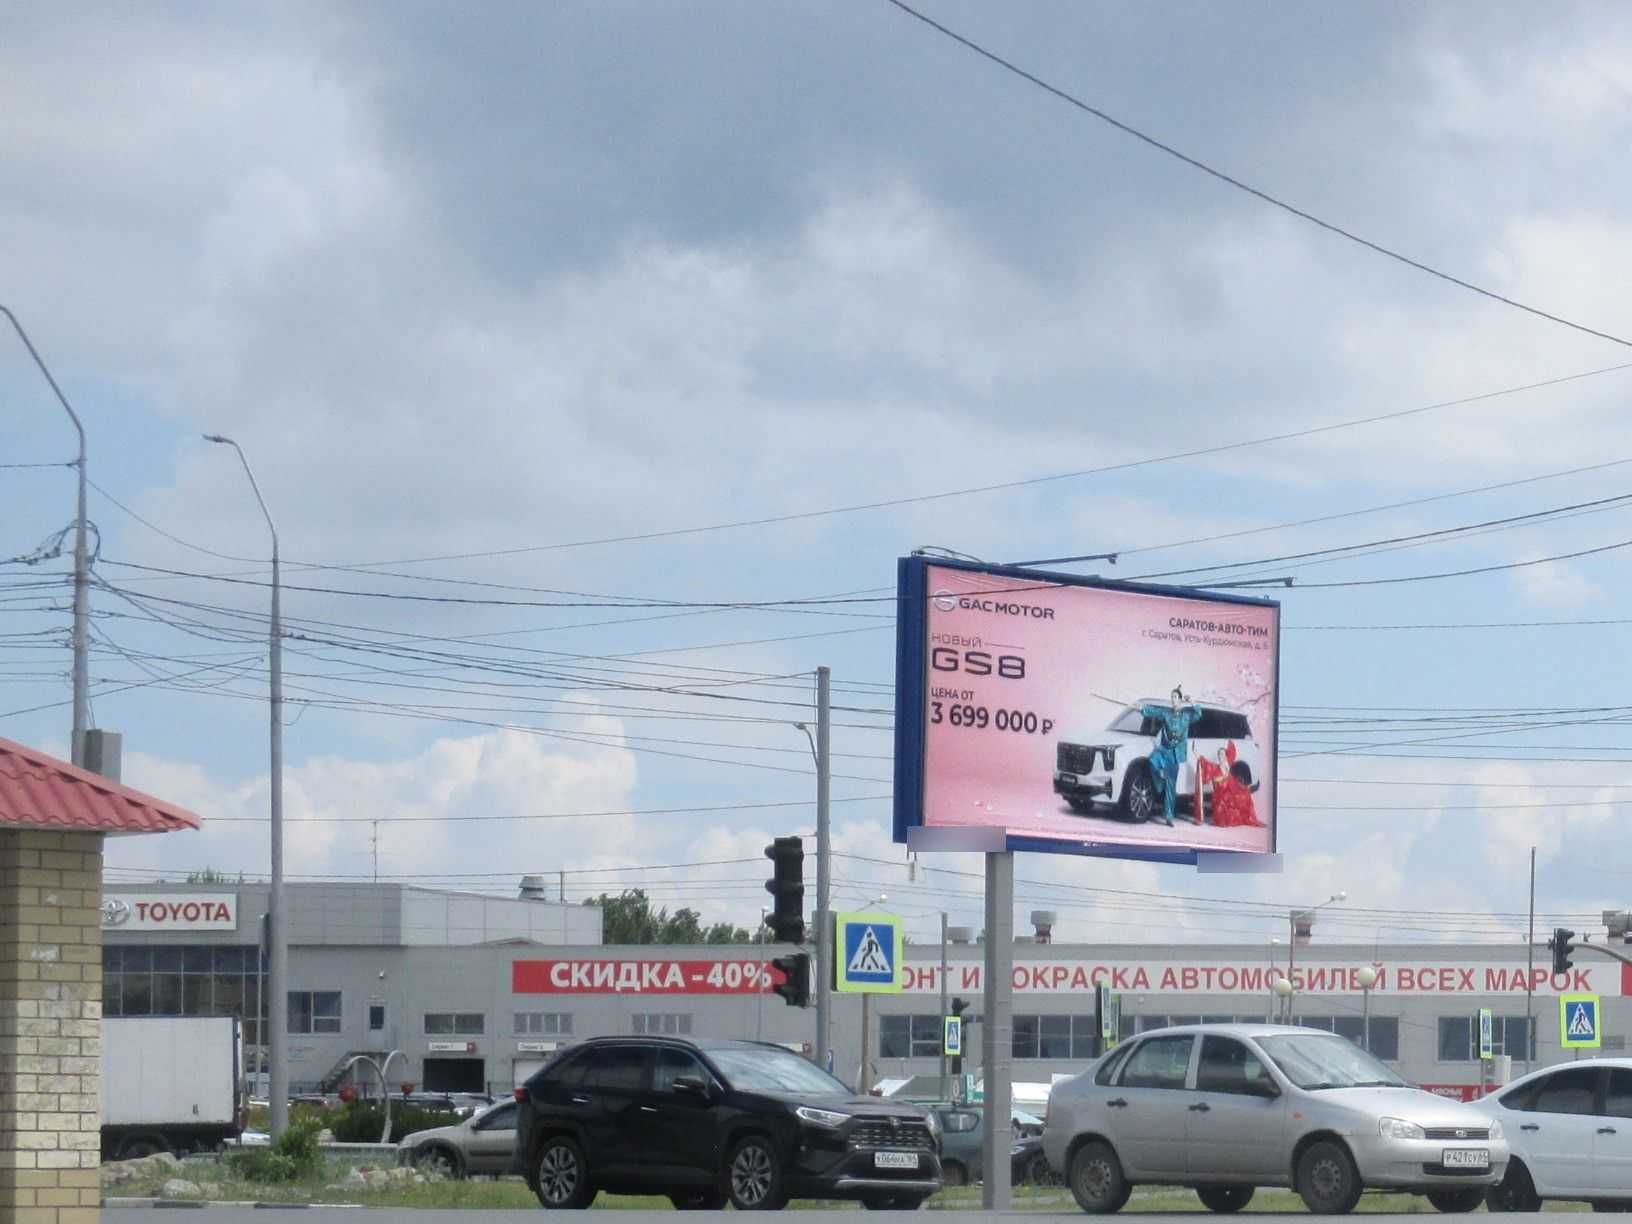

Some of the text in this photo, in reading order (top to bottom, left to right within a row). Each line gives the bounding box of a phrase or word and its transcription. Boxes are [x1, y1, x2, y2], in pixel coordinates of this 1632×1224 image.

[959, 598, 1055, 619] GAC MOTOR
[931, 631, 982, 648] НОВЫЙ
[932, 647, 1026, 680] GS8
[931, 687, 974, 700] ЦЕНА ОТ
[931, 702, 943, 724] 3
[949, 704, 990, 729] 699
[995, 708, 1038, 733] 000
[136, 902, 231, 922] TOYOTA
[550, 962, 772, 992] СКИДКА -40%
[962, 966, 980, 990] И
[1011, 966, 1150, 990] ОКРАСКА
[1160, 960, 1387, 991] АВТОМОБИЛЕЙ
[1397, 967, 1475, 991] ВСЕХ
[1485, 967, 1592, 992] МАРОК
